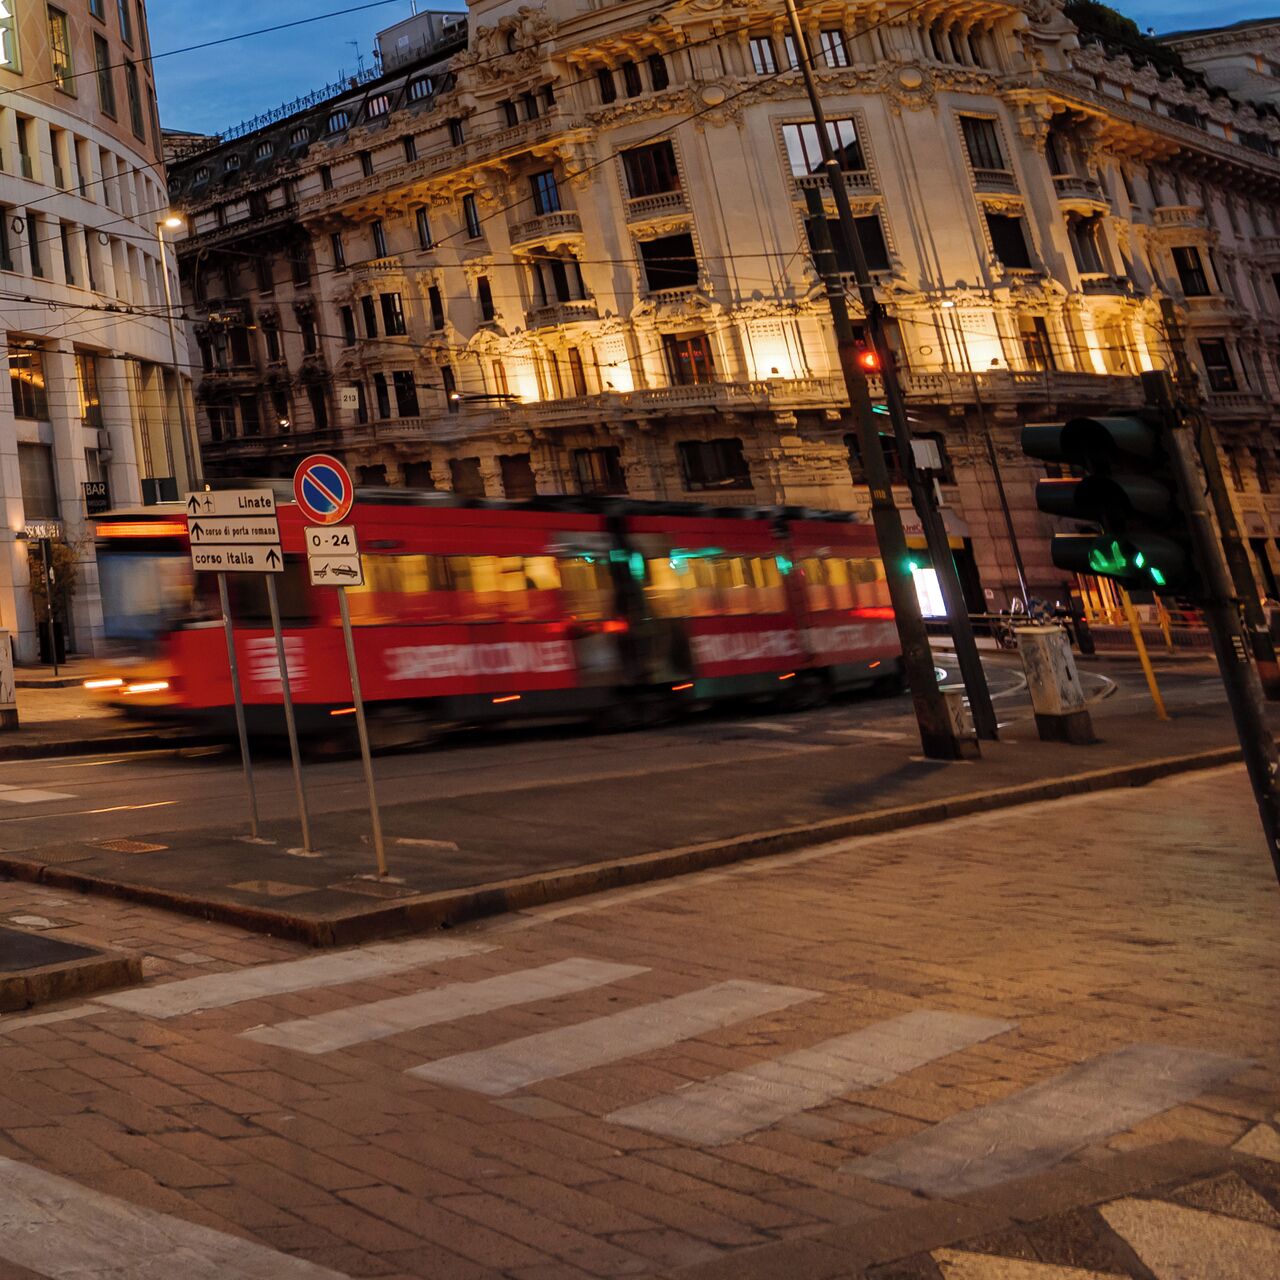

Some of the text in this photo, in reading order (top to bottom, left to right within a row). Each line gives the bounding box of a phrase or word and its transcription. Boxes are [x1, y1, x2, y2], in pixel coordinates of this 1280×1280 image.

[86, 483, 105, 496] BAR
[239, 496, 272, 509] Linate
[205, 525, 276, 538] corso di porta romana
[195, 552, 254, 565] corso italia
